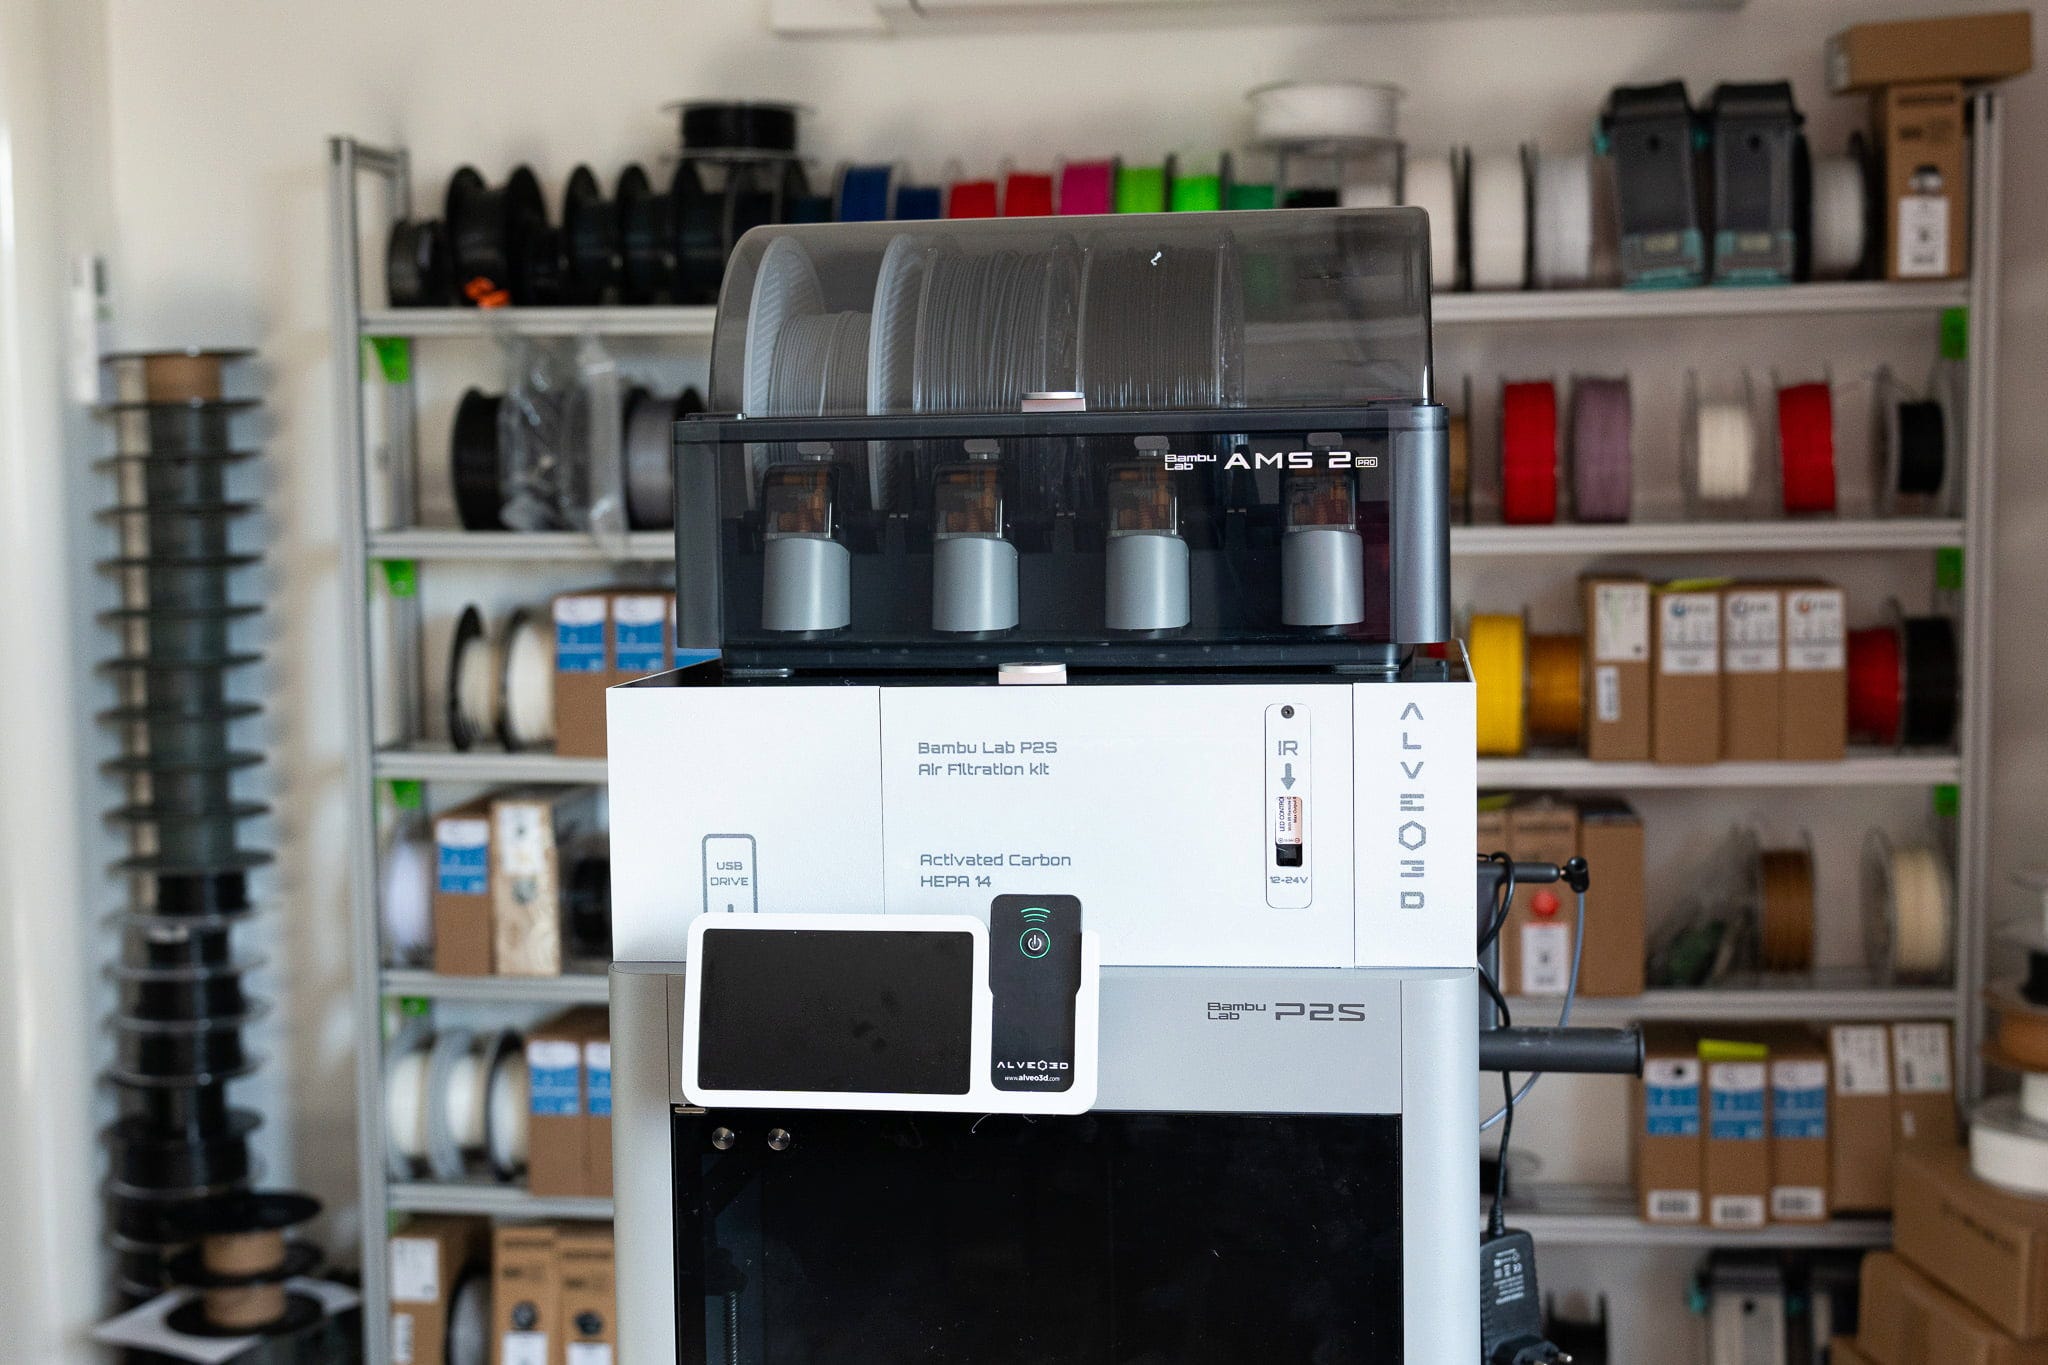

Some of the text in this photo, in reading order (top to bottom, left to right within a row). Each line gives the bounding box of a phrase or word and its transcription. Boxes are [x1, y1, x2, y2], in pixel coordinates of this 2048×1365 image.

[1165, 454, 1217, 462] Bambu
[1224, 451, 1377, 470] AMS 2 PRO
[1165, 462, 1194, 471] Lab
[918, 741, 1058, 754] Bambu Lab P2S
[1278, 740, 1298, 756] IR
[918, 762, 1050, 776] Air Filtration kit
[920, 853, 1072, 867] Activated Carbon
[716, 861, 743, 871] USB
[710, 877, 749, 886] DRIVE
[920, 875, 992, 888] HEPA 14
[1269, 876, 1309, 884] 12-24V
[1207, 1002, 1267, 1011] Bambu
[1207, 1011, 1240, 1020] Lab
[1275, 1002, 1366, 1022] P2S
[996, 1060, 1069, 1071] ALVEO3D
[1004, 1074, 1061, 1082] www.alveo3d.com
